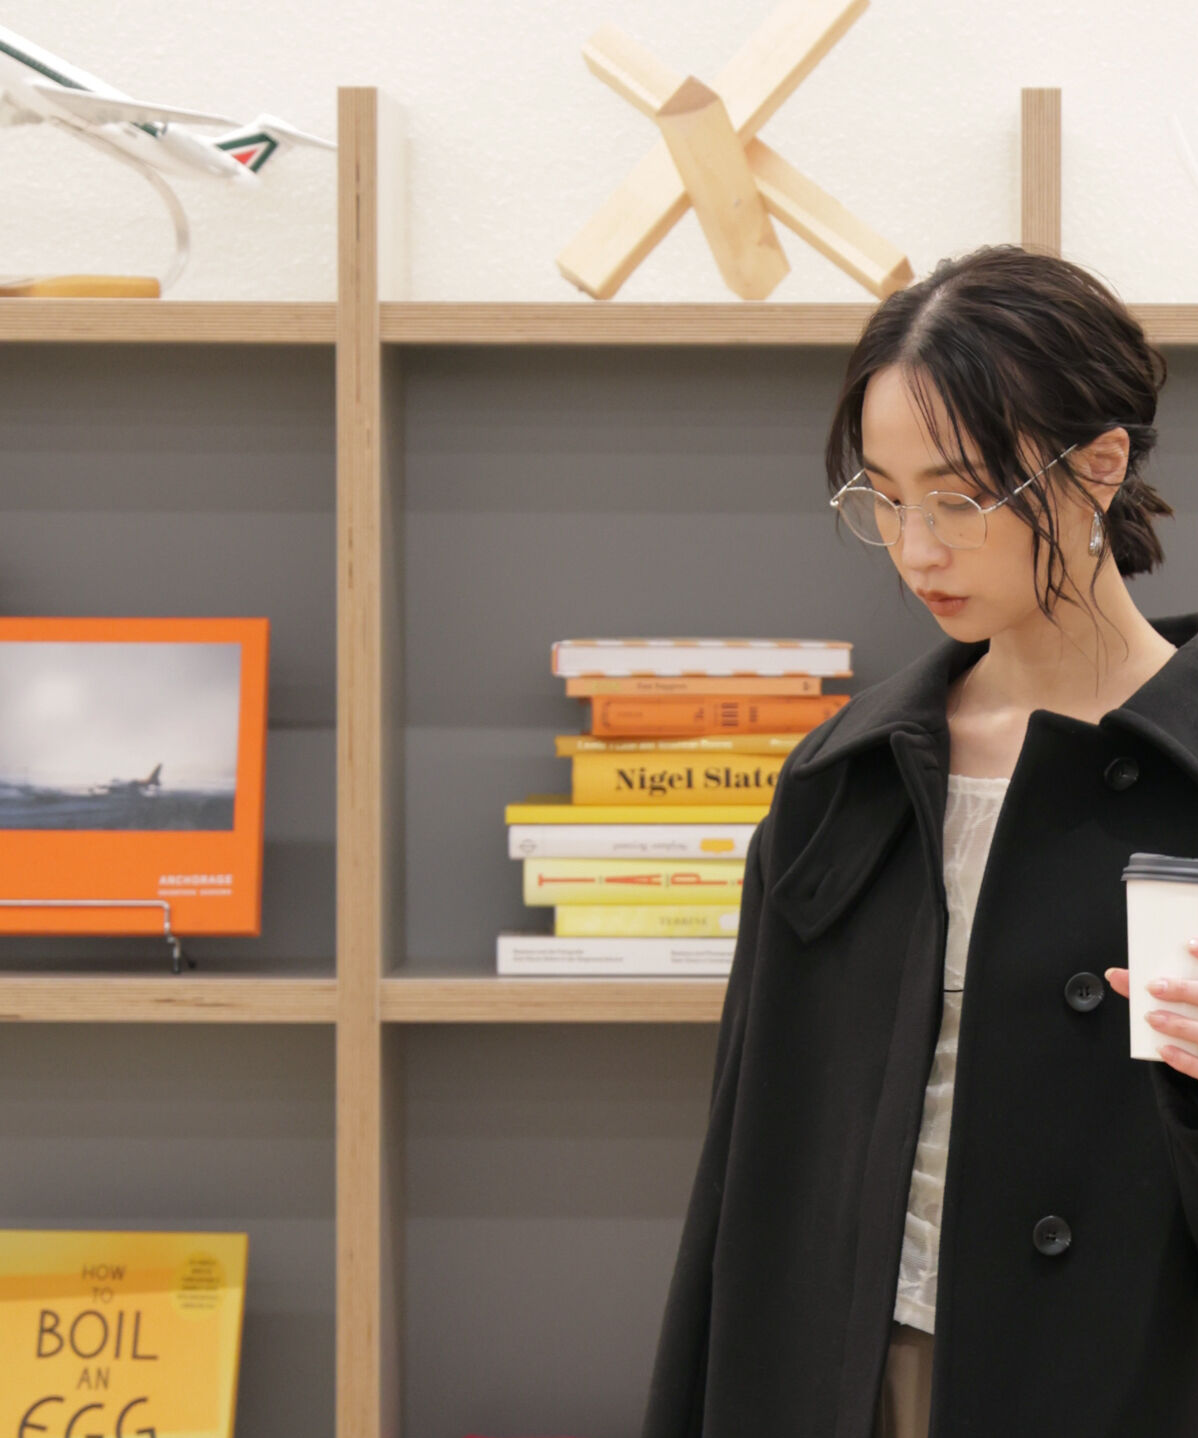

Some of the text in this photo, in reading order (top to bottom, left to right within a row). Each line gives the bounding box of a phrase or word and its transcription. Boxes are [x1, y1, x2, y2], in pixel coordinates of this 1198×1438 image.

[616, 767, 694, 797] Nigel
[82, 1264, 127, 1280] HOW
[92, 1286, 114, 1304] TO
[37, 1309, 158, 1360] BOIL
[76, 1367, 110, 1390] AN
